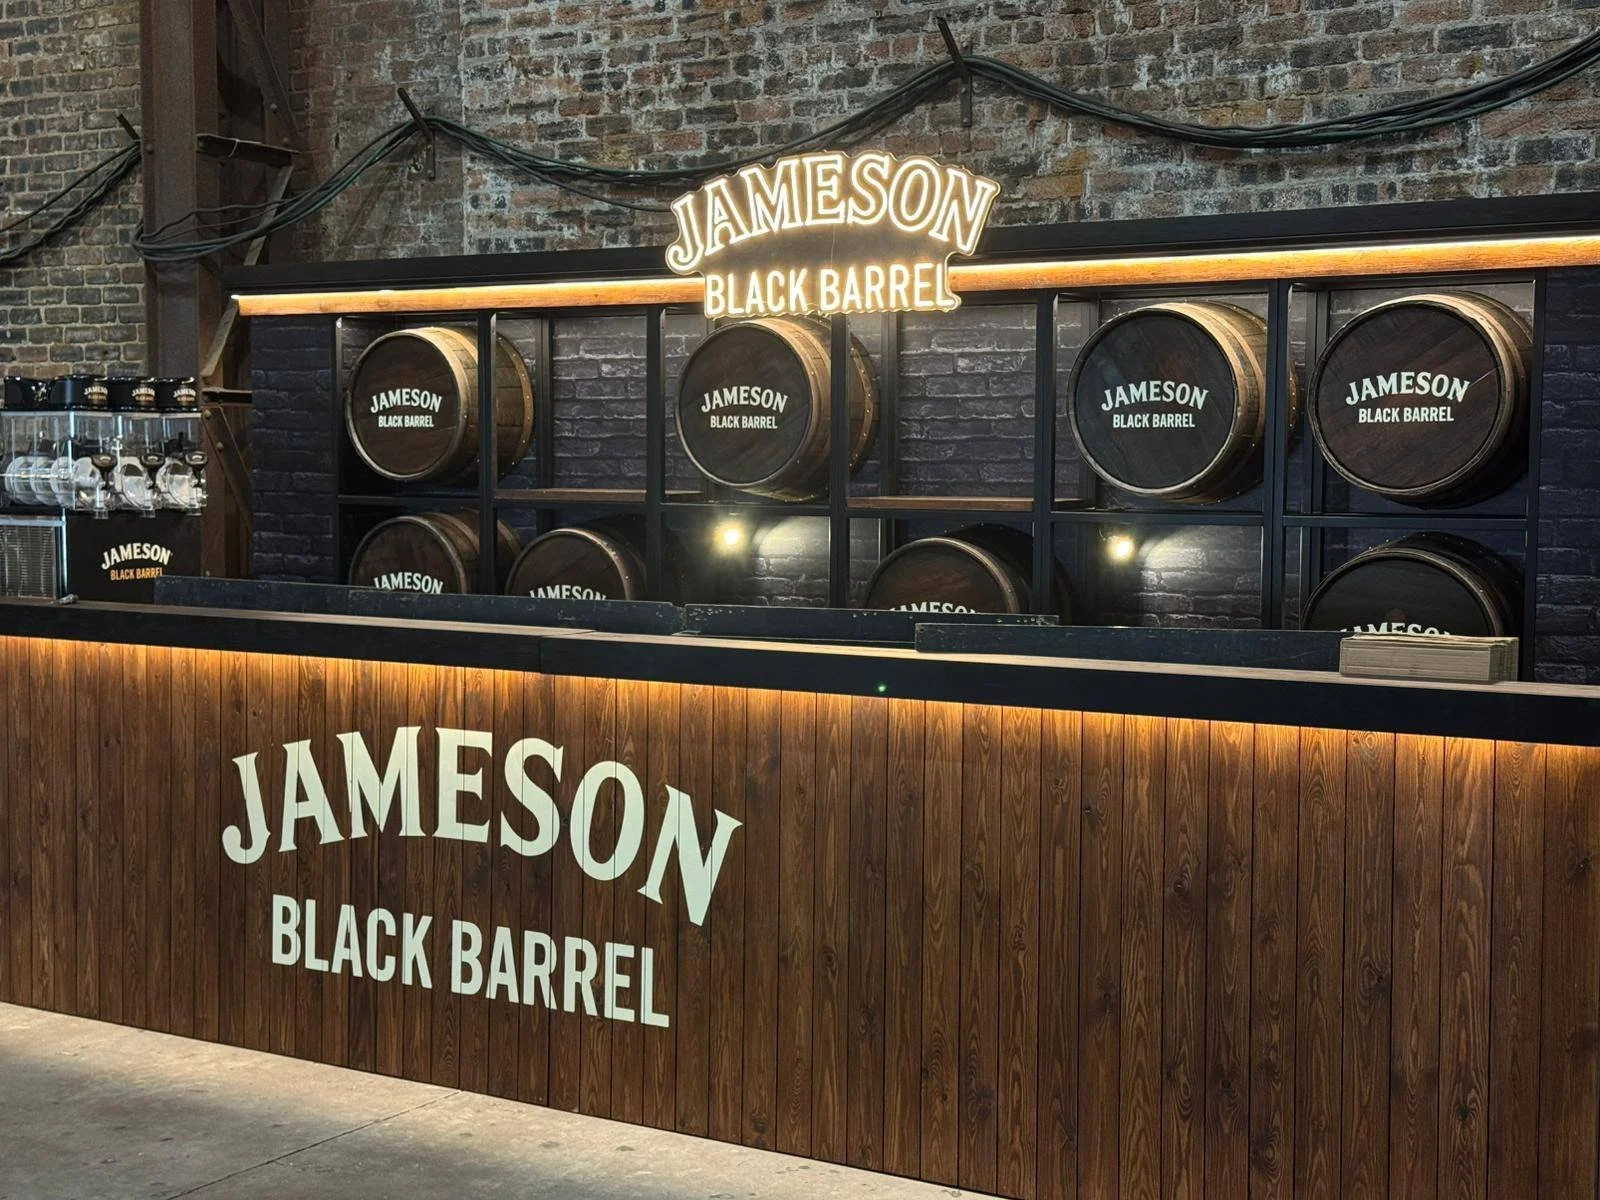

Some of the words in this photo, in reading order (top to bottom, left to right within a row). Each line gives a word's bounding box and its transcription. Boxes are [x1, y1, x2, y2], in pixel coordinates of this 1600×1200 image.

[667, 153, 997, 271] JAMESON
[705, 268, 809, 315] BLACK
[819, 262, 956, 312] BARREL
[370, 388, 443, 414] JAMESON
[701, 386, 789, 414] JAMESON
[1101, 380, 1210, 412] JAMESON
[1345, 371, 1471, 406] JAMESON
[378, 415, 403, 428] BLACK
[404, 415, 435, 428] BARREL
[710, 415, 740, 429] BLACK
[741, 415, 778, 429] BARREL
[1112, 413, 1150, 429] BLACK
[1152, 413, 1196, 428] BARREL
[1358, 407, 1401, 424] BLACK
[1403, 406, 1455, 423] BARREL
[101, 542, 172, 570] JAMESON
[110, 569, 135, 581] BLACK
[222, 726, 743, 926] JAMESON
[272, 894, 434, 989] BLACK
[451, 919, 670, 1028] BARREL
